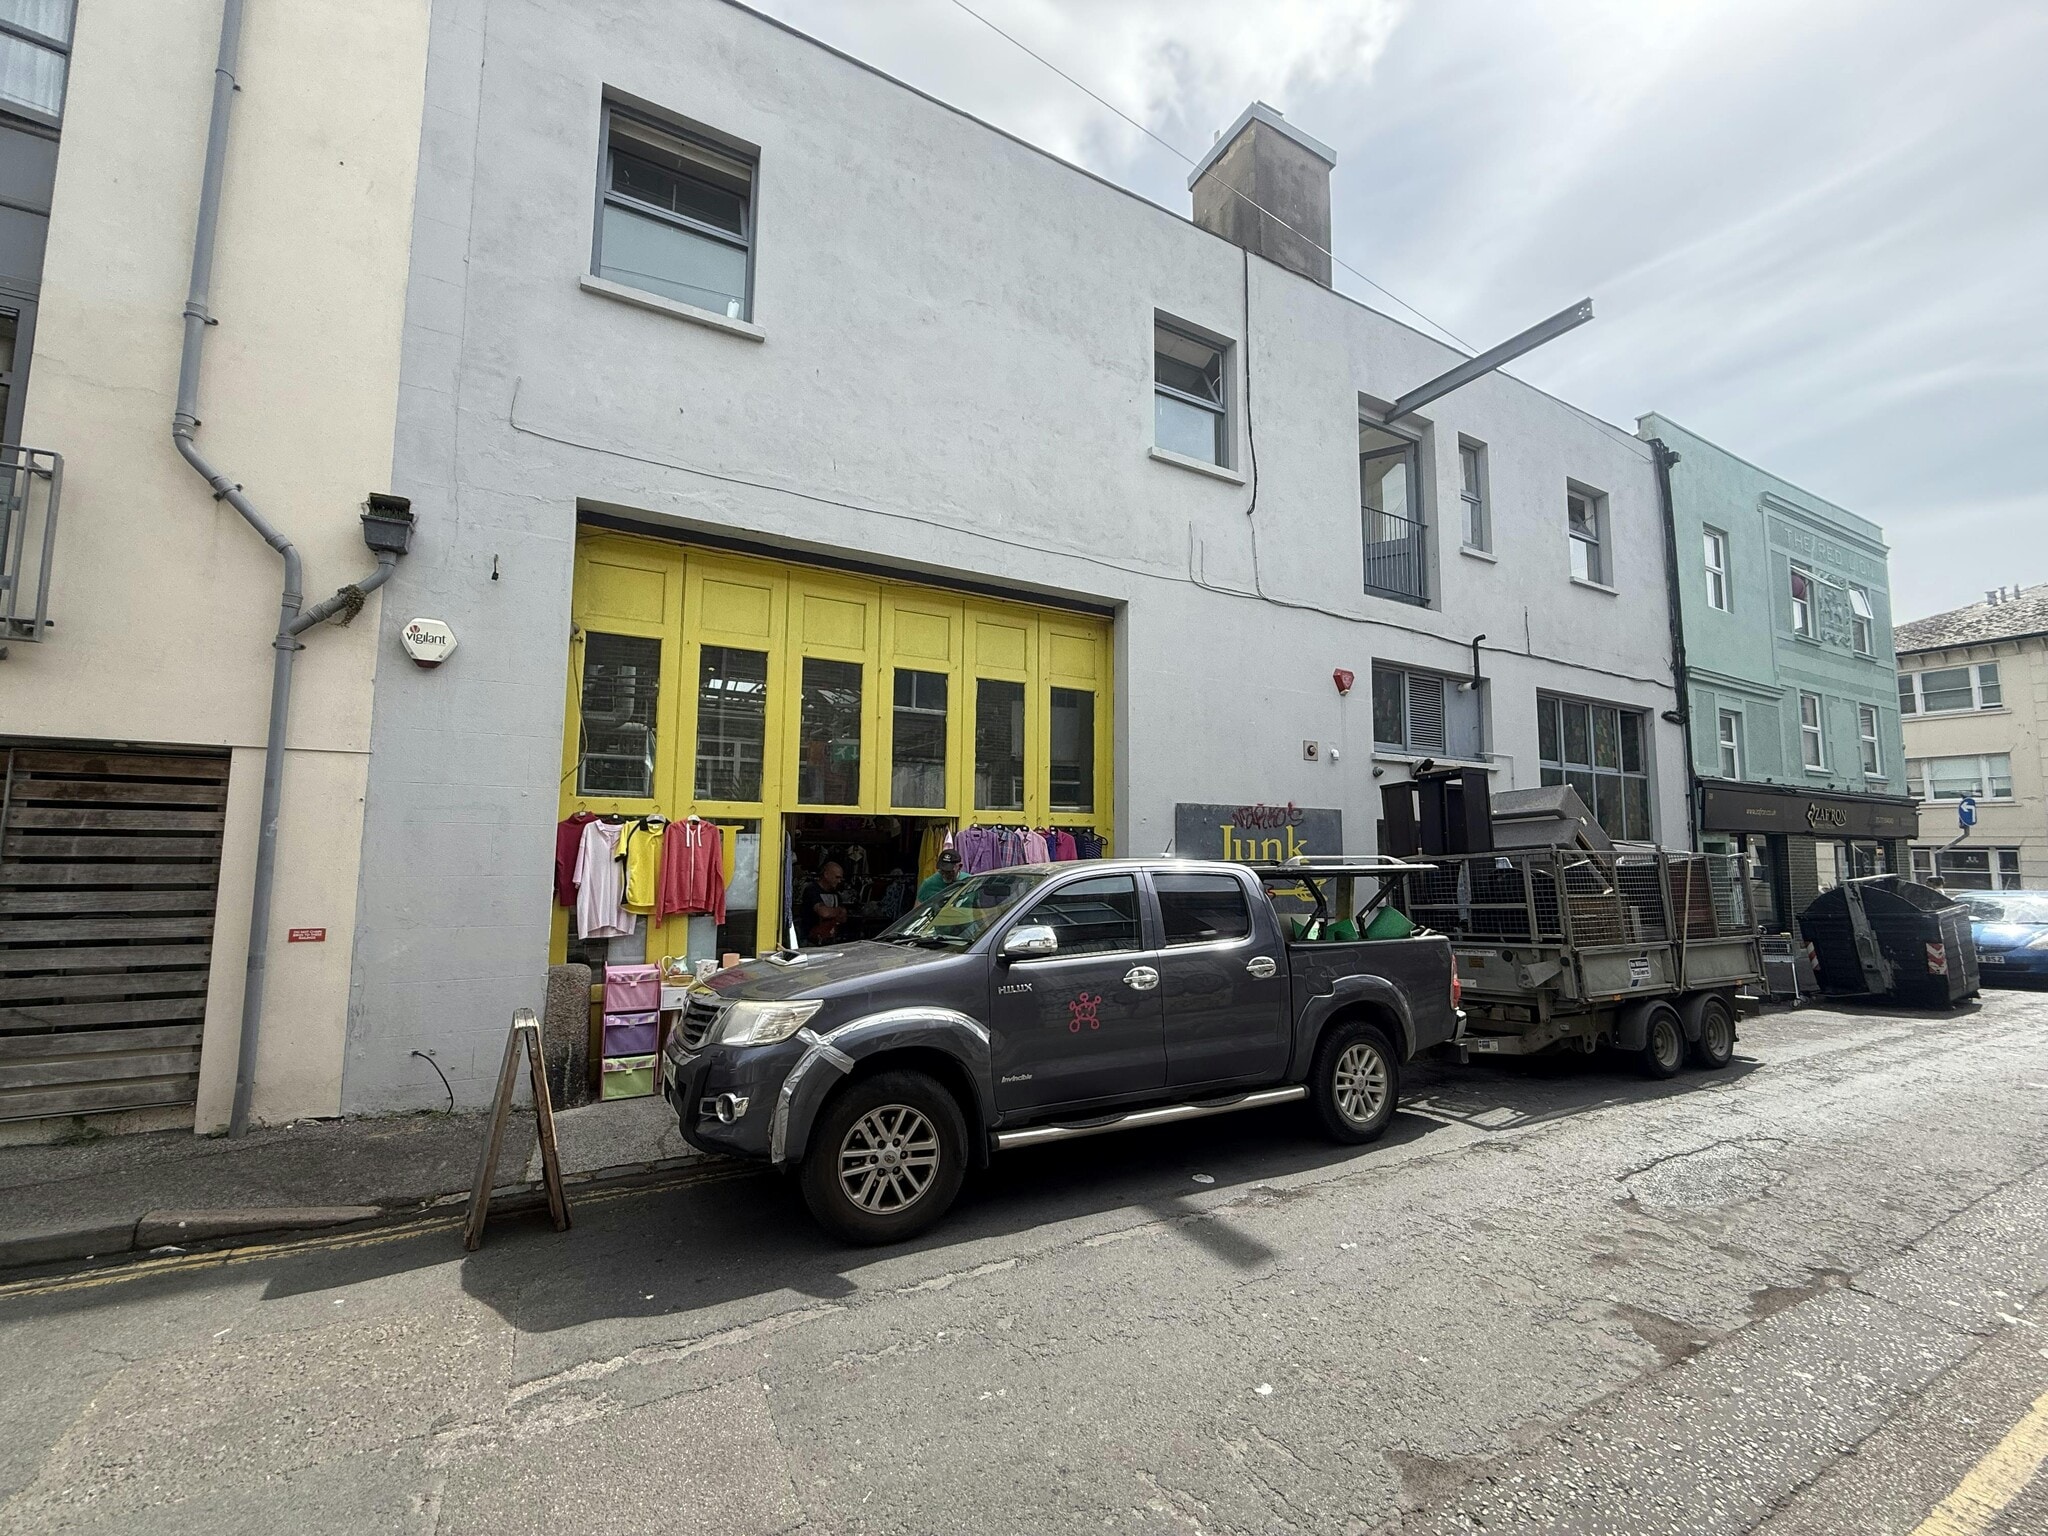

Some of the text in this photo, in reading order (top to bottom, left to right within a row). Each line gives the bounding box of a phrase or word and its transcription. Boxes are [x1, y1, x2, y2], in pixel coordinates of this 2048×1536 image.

[1785, 527, 1811, 553] THE
[1818, 542, 1842, 566] RED
[406, 632, 446, 645] vigilant
[1219, 824, 1310, 863] Junk
[998, 983, 1033, 994] HILUX
